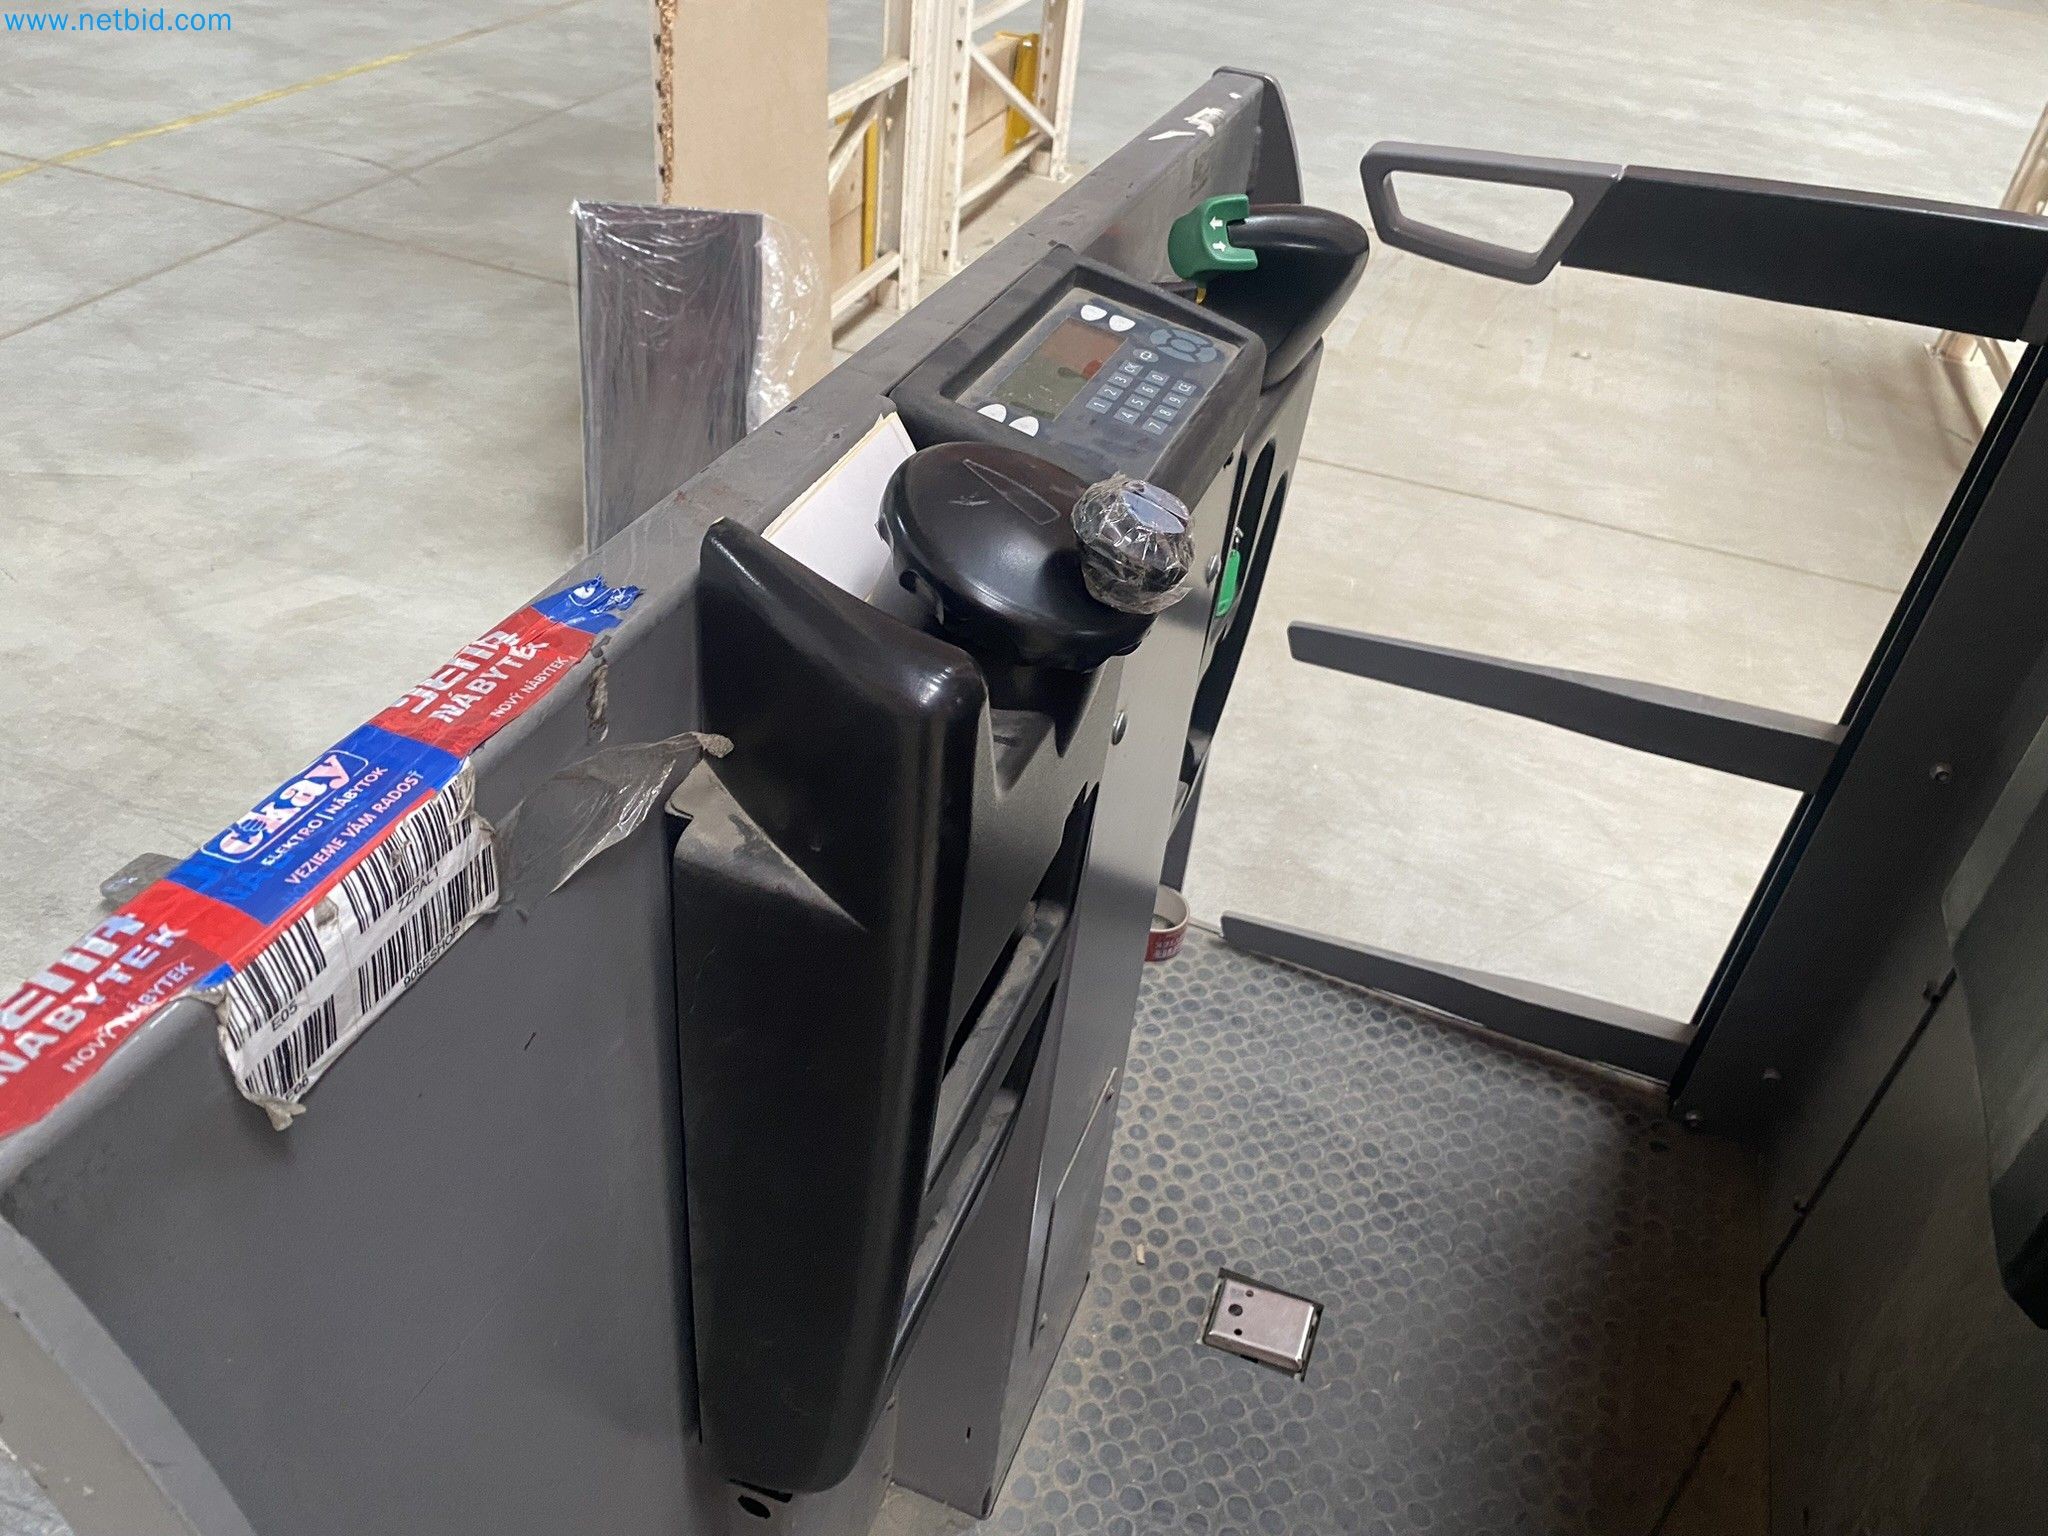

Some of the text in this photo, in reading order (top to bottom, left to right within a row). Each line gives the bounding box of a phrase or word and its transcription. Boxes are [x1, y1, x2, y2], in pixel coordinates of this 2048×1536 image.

[490, 656, 569, 718] NOVÝ NÁBYTEK
[261, 766, 389, 866] ELEKTRO NÁBYTOK
[284, 770, 424, 886] VEZIEME VÁM RADOSŤ
[270, 1001, 298, 1032] E05
